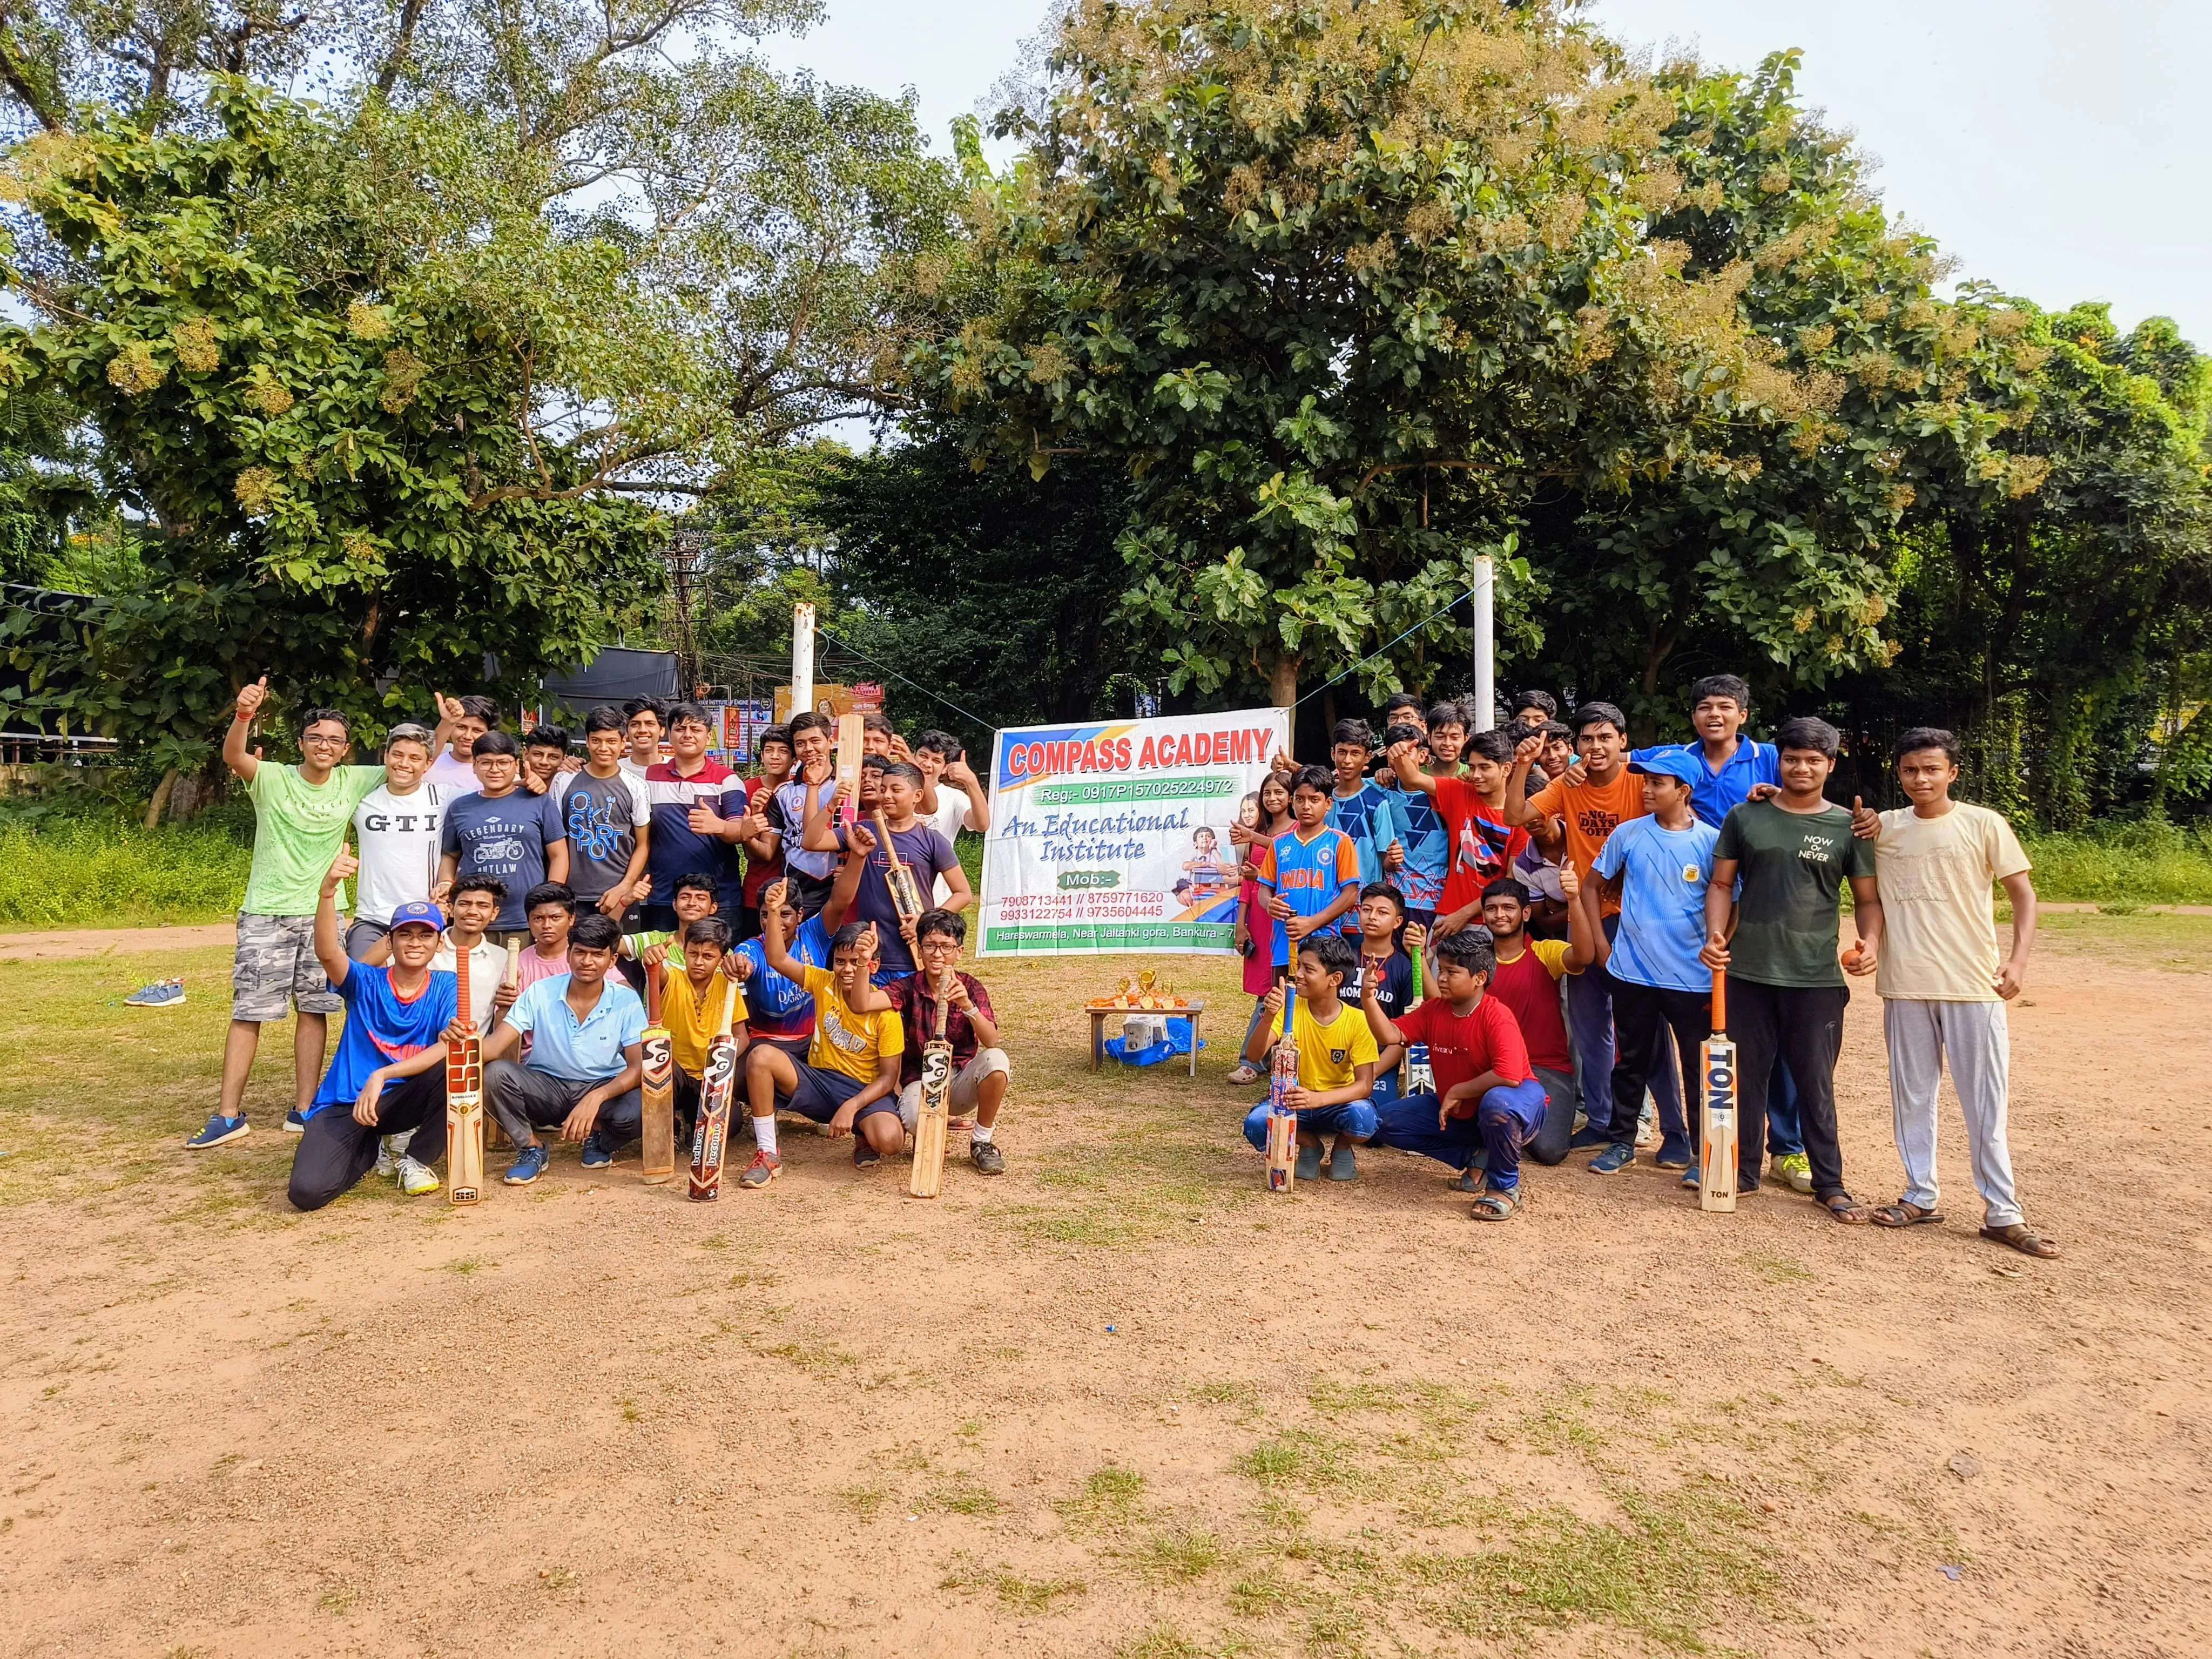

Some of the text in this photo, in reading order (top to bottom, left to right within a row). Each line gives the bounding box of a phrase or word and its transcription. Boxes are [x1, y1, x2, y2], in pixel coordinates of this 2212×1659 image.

[1009, 729, 1273, 775] COMPASS ACADEMY
[1042, 780, 1233, 803] Reg:- 0917P157025224972
[1588, 810, 1606, 819] NO
[365, 814, 438, 832] GTI
[1002, 807, 1190, 840] An Educational
[1581, 818, 1615, 827] DAYS
[465, 824, 524, 840] LEGENDARY
[569, 814, 623, 860] SPORT
[1586, 827, 1610, 837] OFF
[1804, 835, 1833, 846] NOW
[1040, 838, 1145, 861] Institute
[1798, 849, 1829, 862] NEVER
[478, 864, 517, 874] OUTLAW
[1066, 874, 1112, 886] Mob:-
[1001, 894, 1072, 907] 7908713441
[1088, 893, 1163, 903] 8759771620
[1000, 908, 1072, 921] 9933122754
[1087, 906, 1163, 917] 9735604445
[996, 930, 1070, 942] Hareswarmela,
[1073, 928, 1098, 940] Near
[1100, 927, 1139, 939] Jaltanki
[1142, 928, 1169, 940] gora,
[1172, 926, 1217, 938] Bankura
[1228, 928, 1235, 940] 7
[1339, 987, 1361, 998] MOM
[1286, 1051, 1295, 1070] new
[1373, 1080, 1386, 1091] 23
[1707, 1049, 1734, 1109] TON
[692, 1125, 705, 1166] believe.
[455, 1191, 475, 1200] SS
